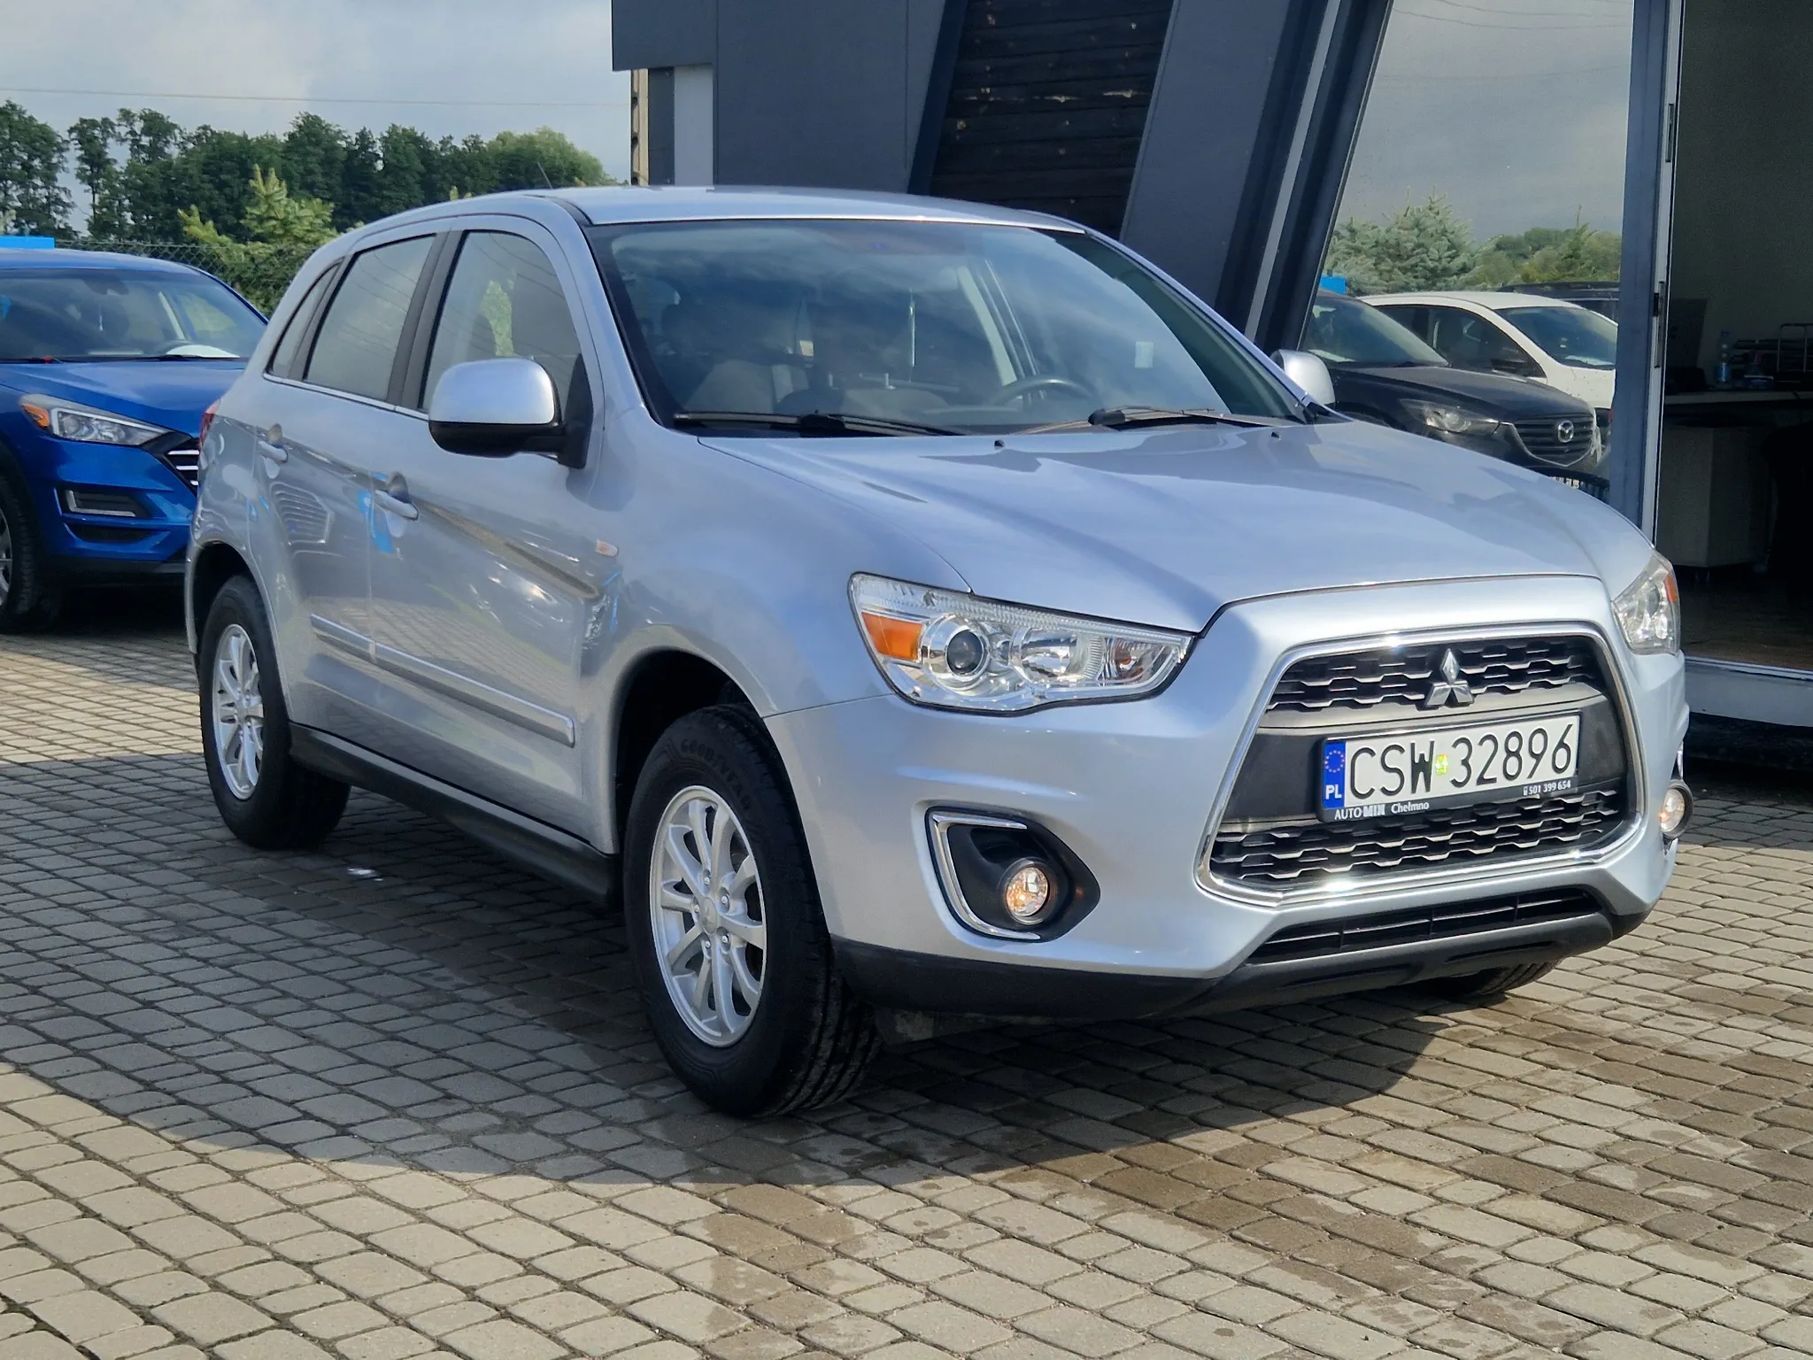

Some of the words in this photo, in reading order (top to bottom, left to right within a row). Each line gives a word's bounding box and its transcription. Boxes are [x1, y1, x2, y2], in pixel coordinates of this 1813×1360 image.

[1350, 740, 1435, 800] CSW
[1449, 723, 1574, 789] 32896
[1325, 784, 1342, 800] PL
[1543, 782, 1557, 793] 399
